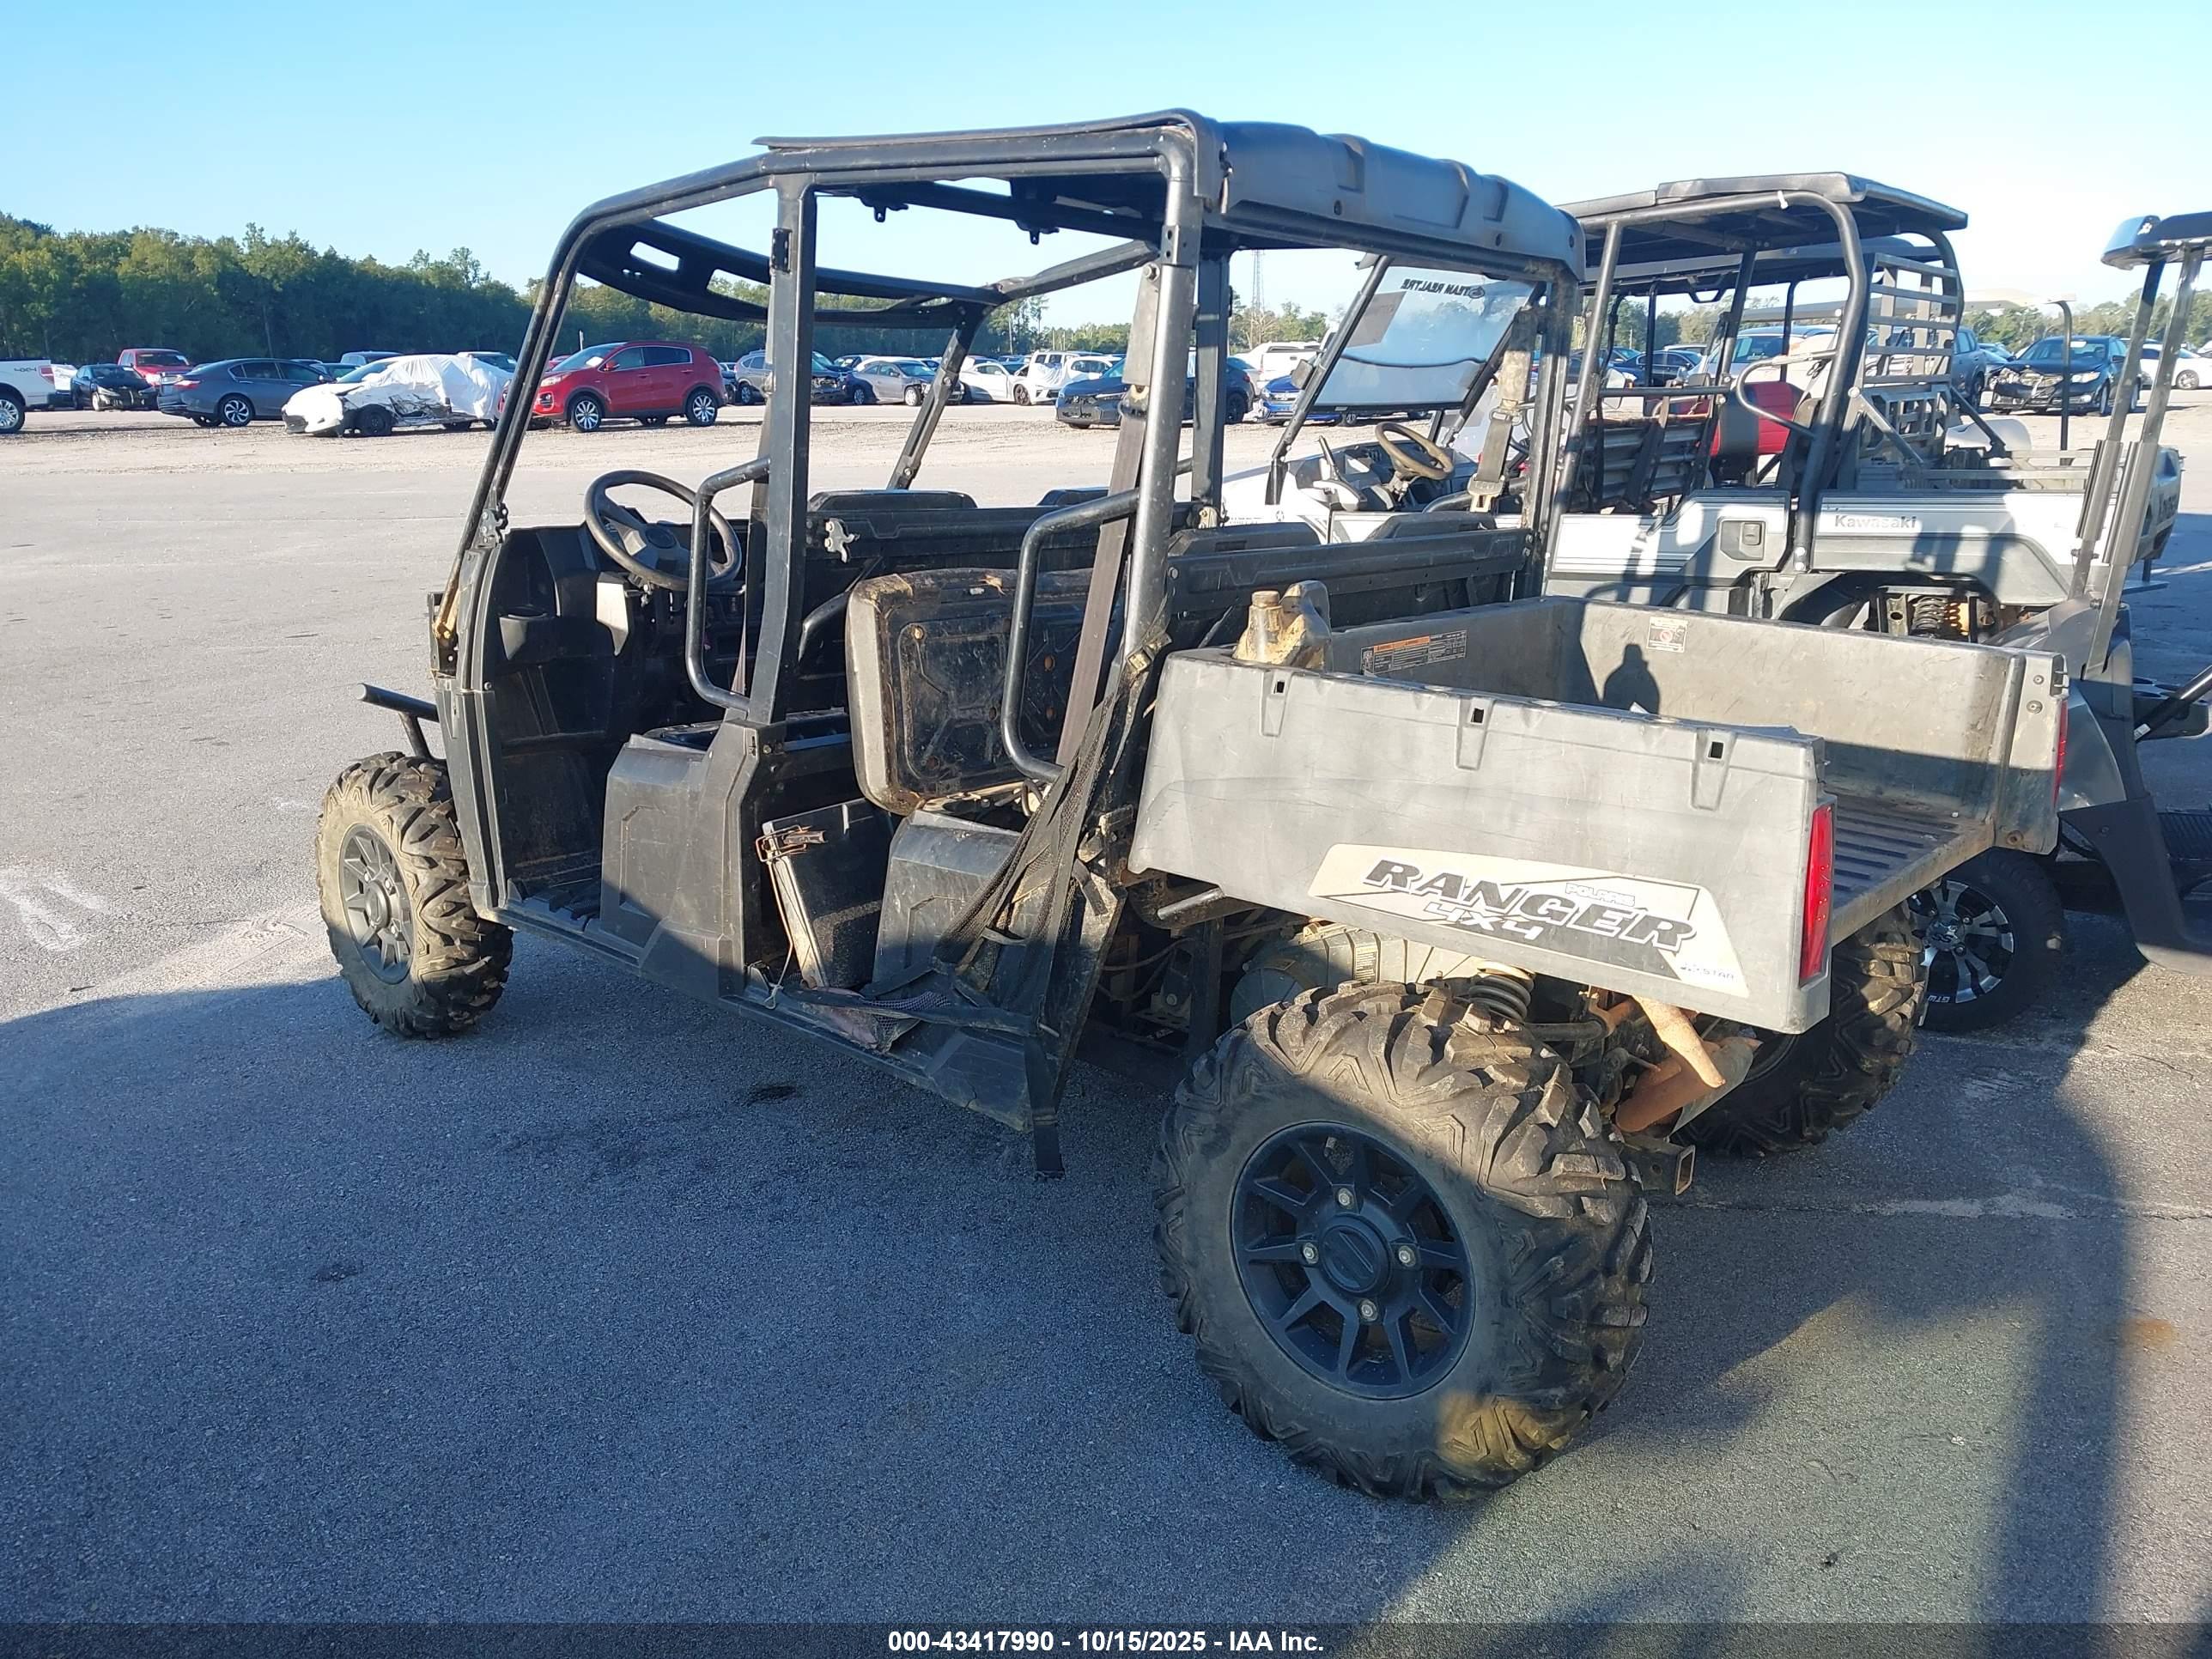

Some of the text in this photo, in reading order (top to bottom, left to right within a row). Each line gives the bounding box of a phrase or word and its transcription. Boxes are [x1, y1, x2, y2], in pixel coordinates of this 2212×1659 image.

[1834, 515, 1917, 529] Kawasaki
[1363, 860, 1697, 953] RANGER
[1565, 883, 1635, 907] POLARIS
